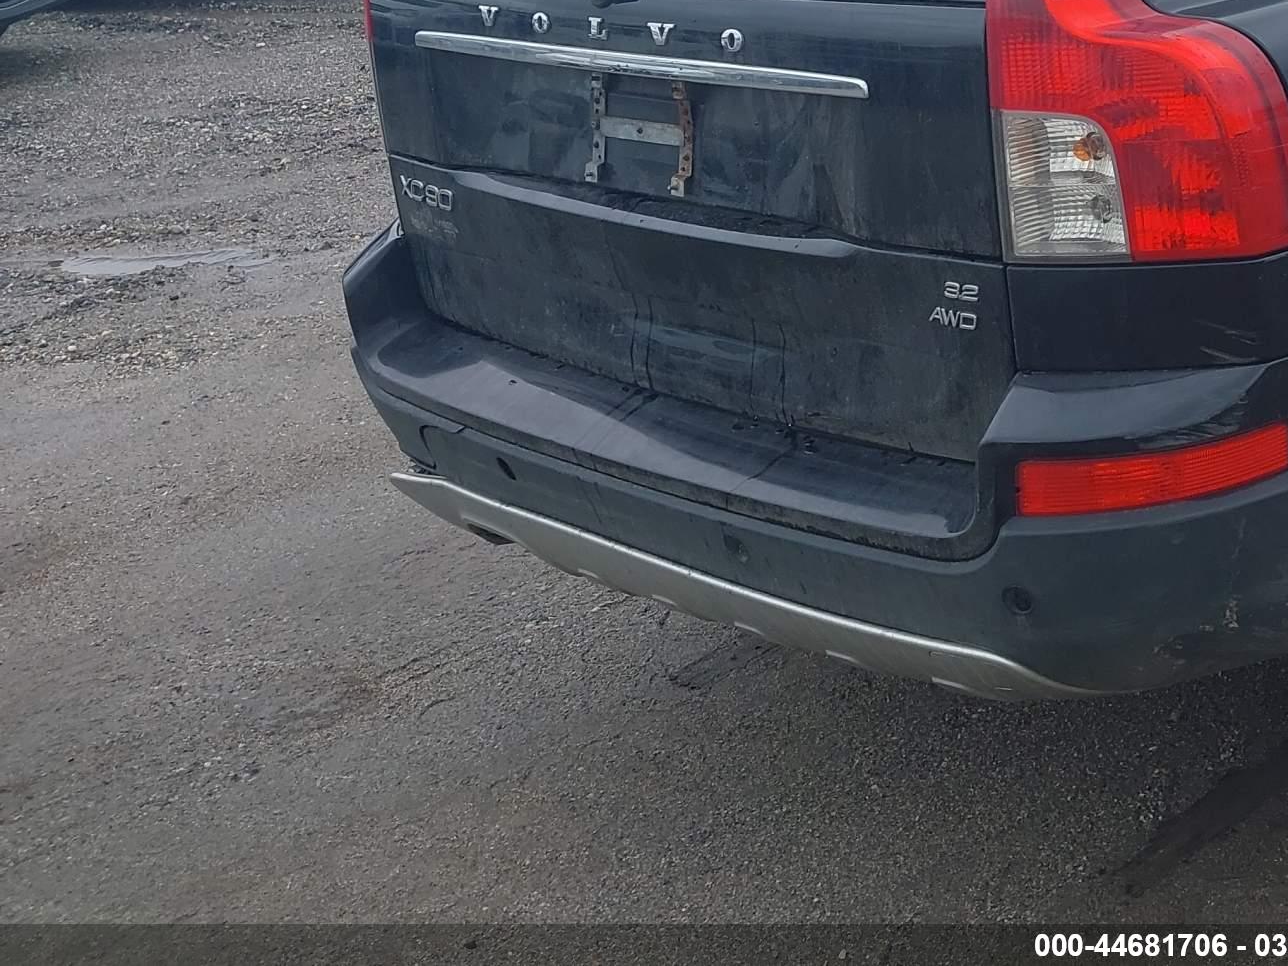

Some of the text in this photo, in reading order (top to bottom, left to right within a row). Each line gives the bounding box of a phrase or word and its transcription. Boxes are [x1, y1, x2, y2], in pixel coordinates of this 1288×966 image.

[478, 4, 744, 53] VOLVO
[399, 175, 453, 211] XC90
[929, 306, 977, 330] AWD
